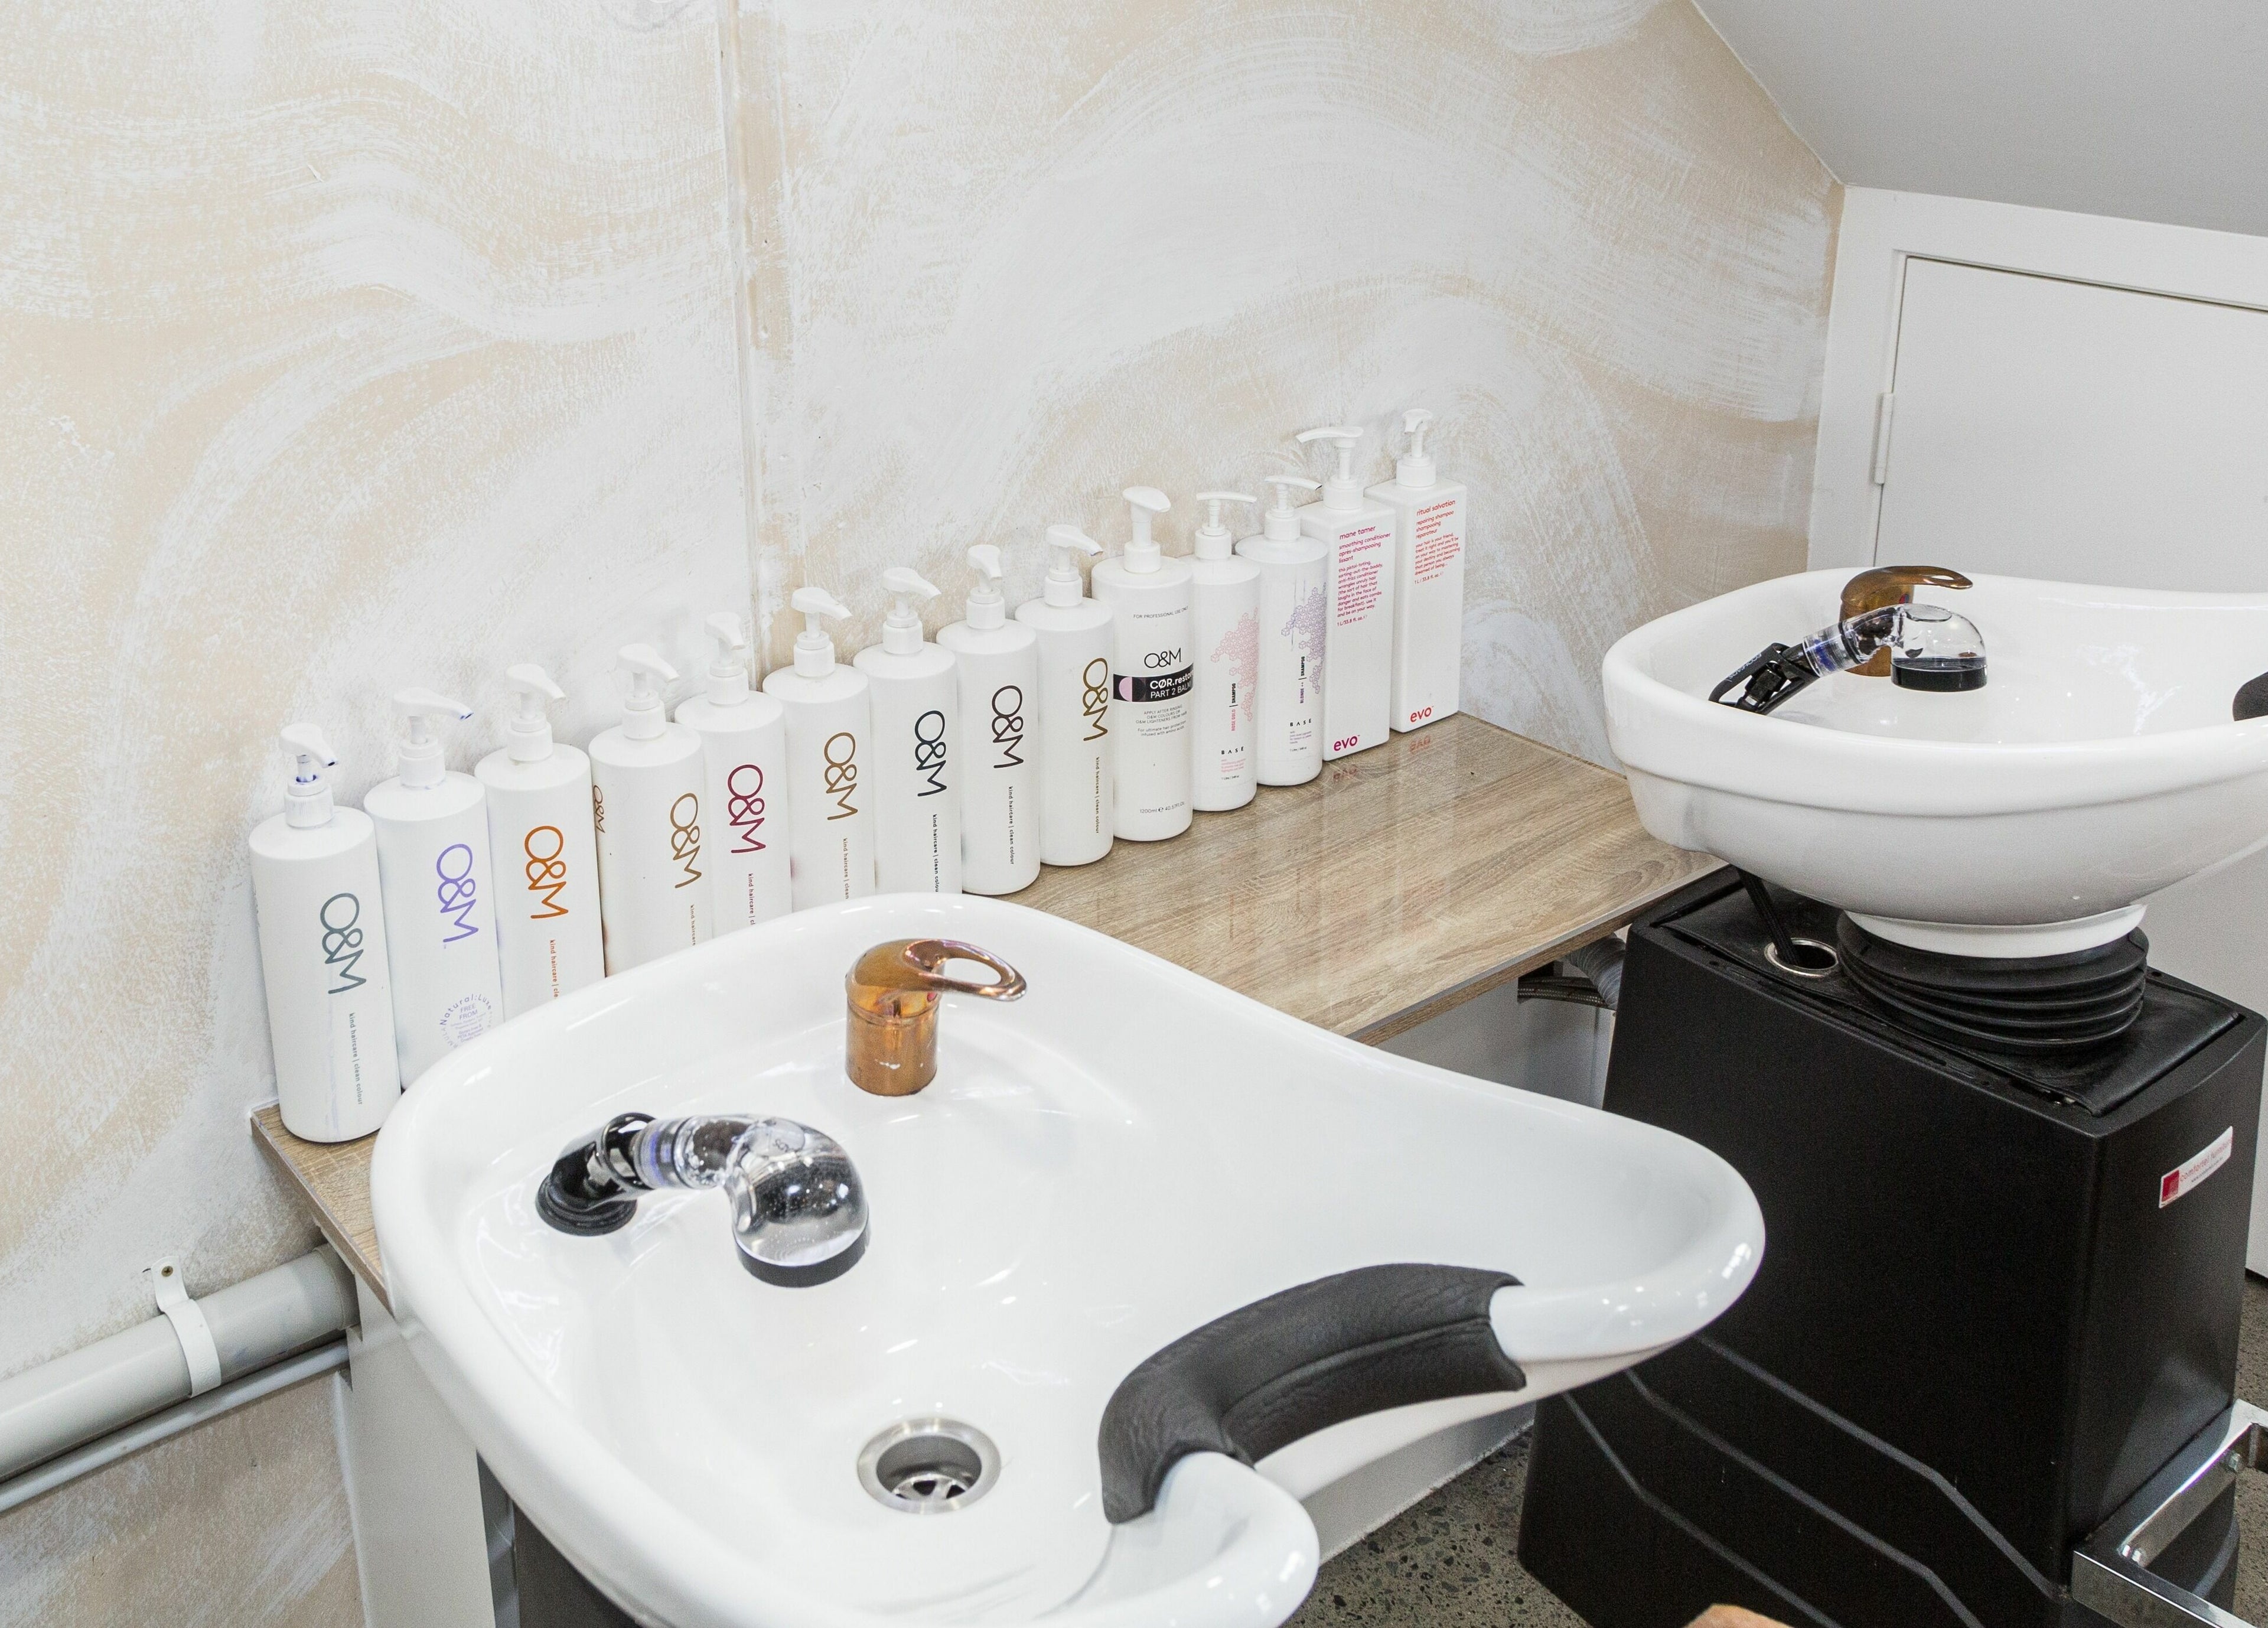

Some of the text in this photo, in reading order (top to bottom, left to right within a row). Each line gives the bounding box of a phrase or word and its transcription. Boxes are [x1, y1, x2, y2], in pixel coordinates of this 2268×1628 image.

[1417, 500, 1455, 517] ritual salvation
[1416, 510, 1454, 526] repairing shampoo
[1339, 533, 1391, 549] smoothing conditioner
[1340, 526, 1376, 540] mane tamer
[1357, 570, 1378, 578] conditioner
[1144, 647, 1181, 668] O&M
[1082, 657, 1109, 742] O&M
[1151, 689, 1170, 699] PART
[1171, 688, 1176, 696] 2
[1290, 718, 1312, 727] BASE
[1410, 707, 1432, 722] evo
[992, 685, 1024, 769] O&M
[1221, 747, 1244, 755] BASE
[1334, 735, 1358, 751] evo
[914, 710, 947, 797] O&M
[824, 731, 858, 820] O&M
[593, 785, 605, 833] O&M
[728, 764, 766, 854] O&M
[670, 793, 702, 888] O&M
[524, 825, 569, 919] O&M
[436, 843, 479, 943] O&M
[320, 893, 367, 995] O&M
[459, 1009, 478, 1020] FROM
[460, 1003, 476, 1012] FREE
